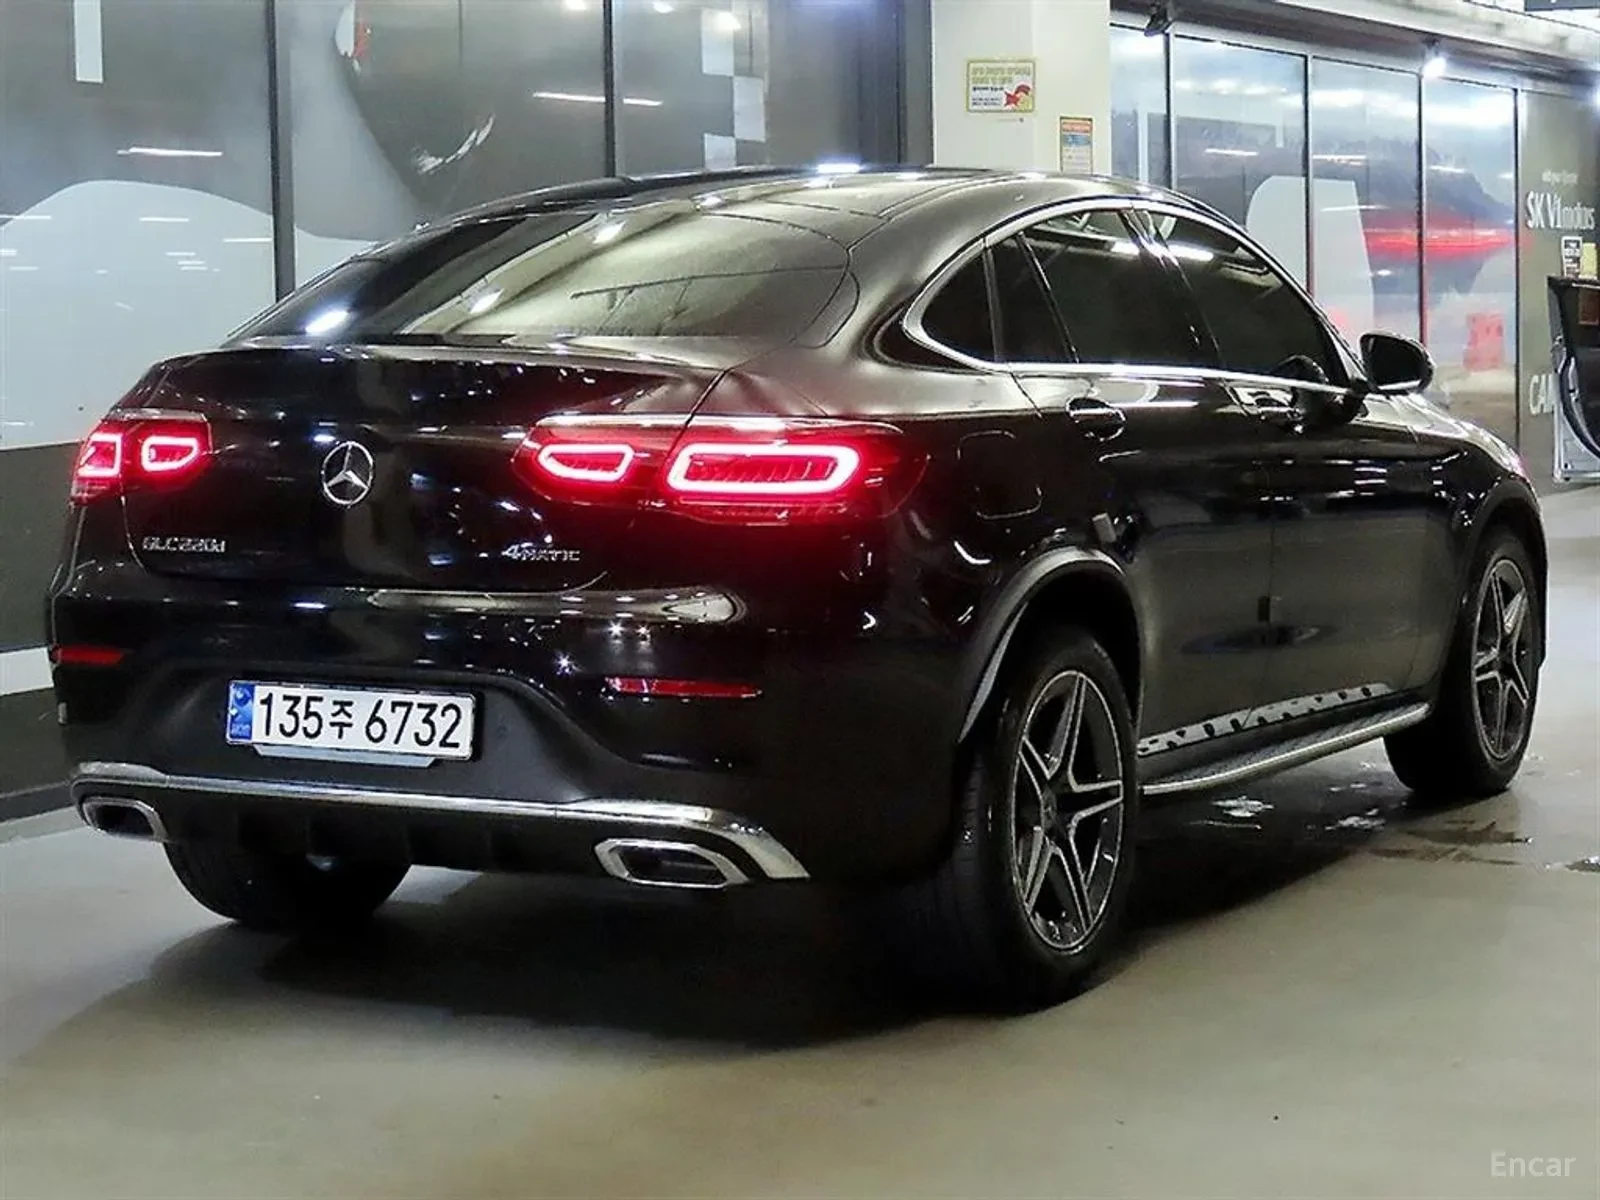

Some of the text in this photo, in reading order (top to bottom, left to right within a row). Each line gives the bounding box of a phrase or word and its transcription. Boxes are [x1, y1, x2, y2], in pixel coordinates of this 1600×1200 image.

[1526, 191, 1545, 229] SK
[259, 692, 463, 748] 135주 6732
